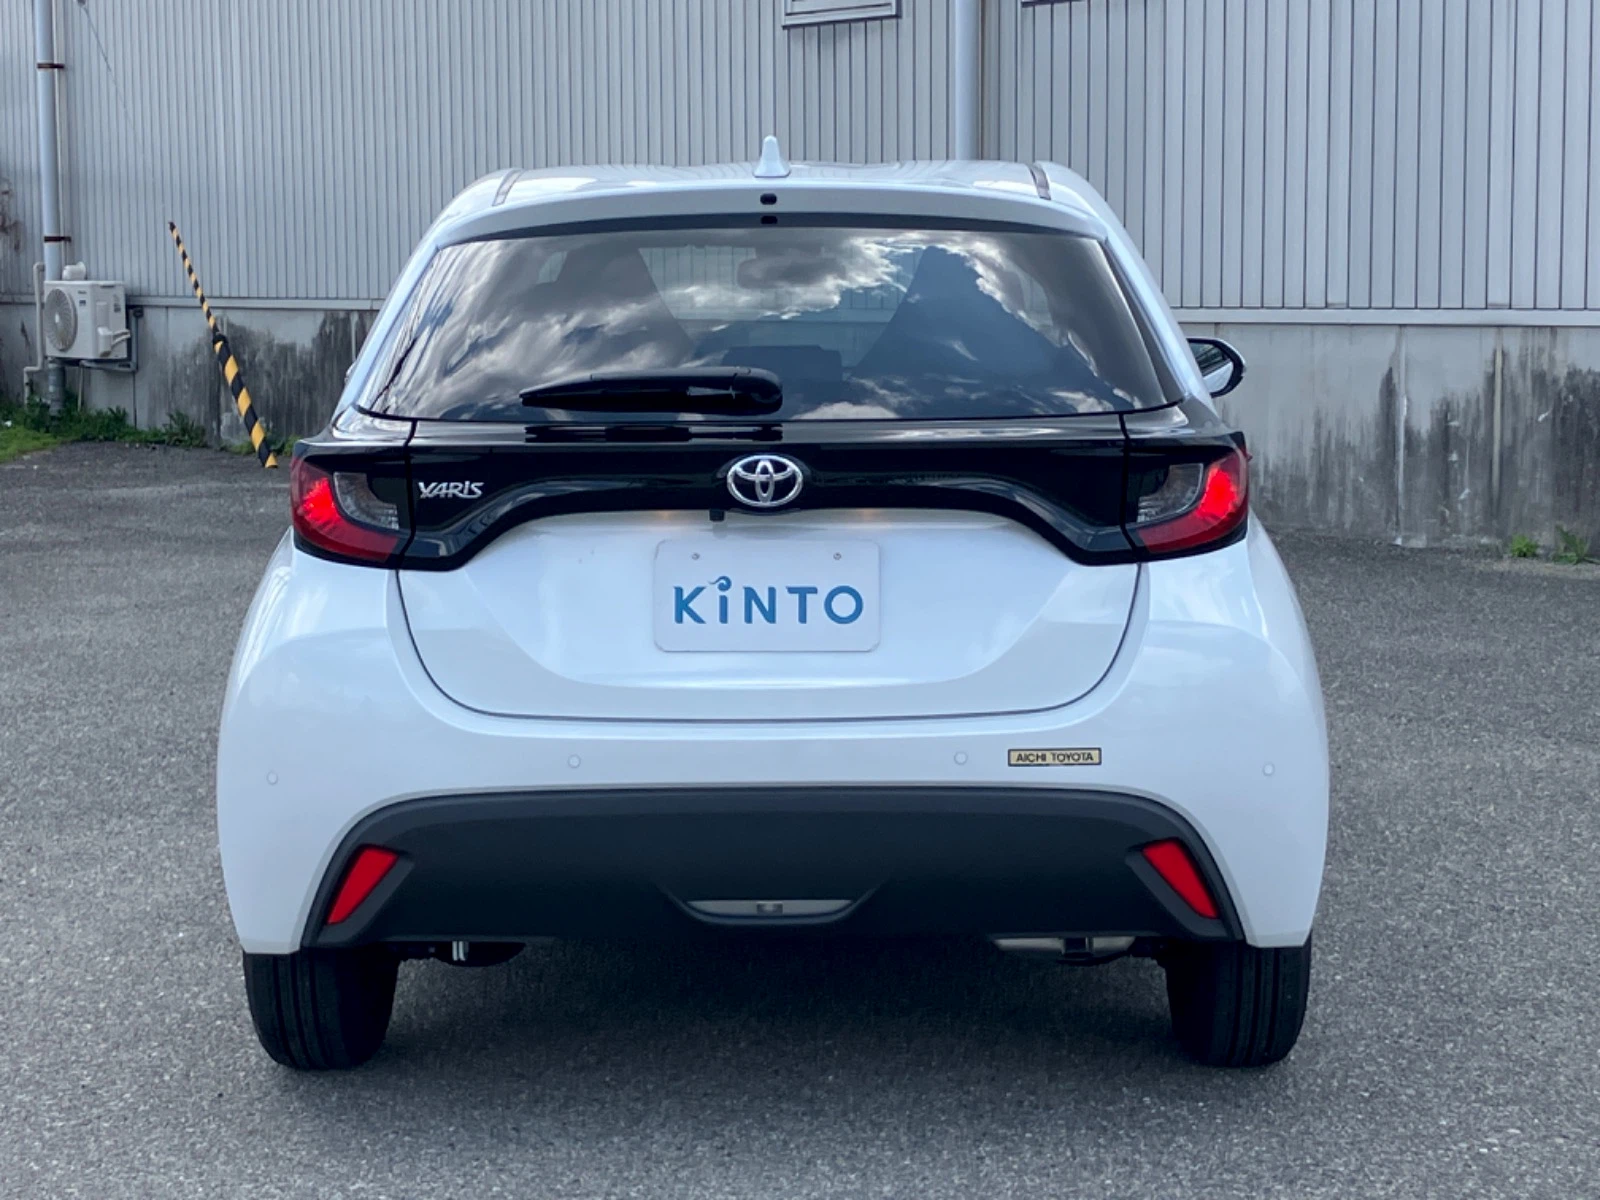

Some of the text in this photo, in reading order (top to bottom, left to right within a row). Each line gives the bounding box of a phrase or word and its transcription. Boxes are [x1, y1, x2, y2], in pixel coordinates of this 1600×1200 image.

[418, 480, 485, 499] YARIS
[1015, 751, 1095, 763] AICHI TOYOTA
